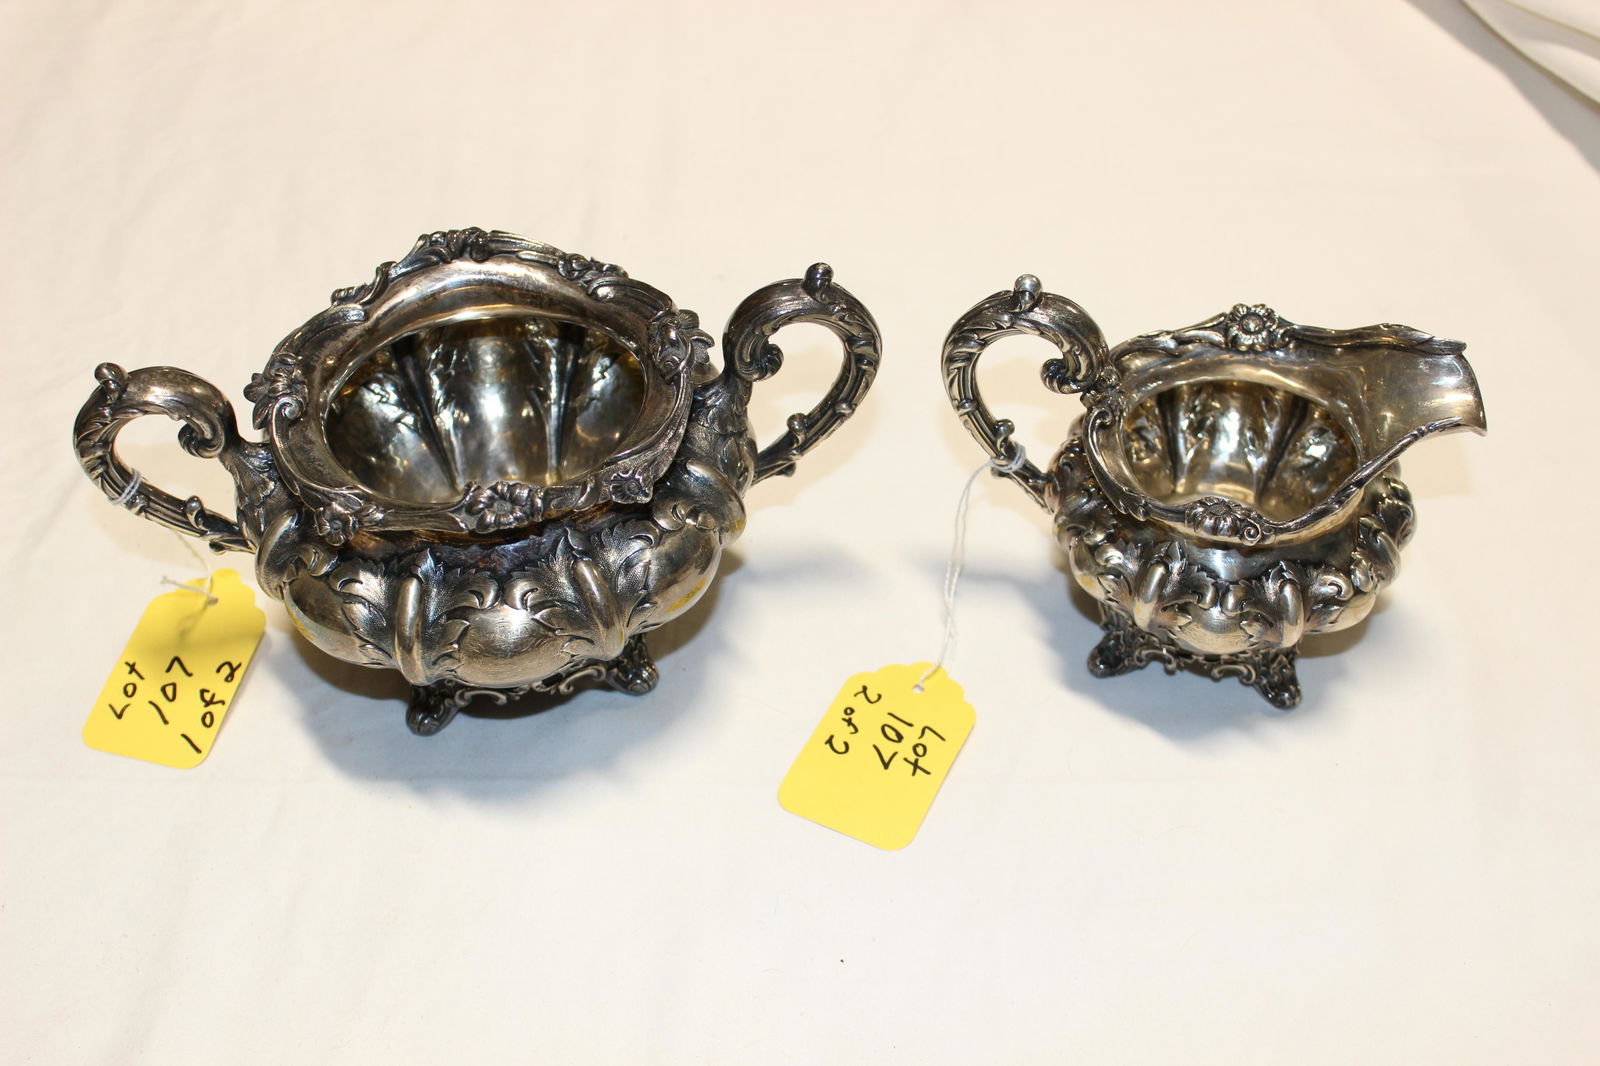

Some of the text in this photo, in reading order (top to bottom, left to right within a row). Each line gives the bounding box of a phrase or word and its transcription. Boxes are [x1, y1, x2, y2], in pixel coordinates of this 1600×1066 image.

[108, 661, 145, 720] Lot
[148, 656, 194, 726] 107
[180, 660, 243, 754] 1 of 2
[824, 685, 882, 755] 2 of 2
[872, 712, 915, 771] 107
[903, 725, 946, 777] Lot
